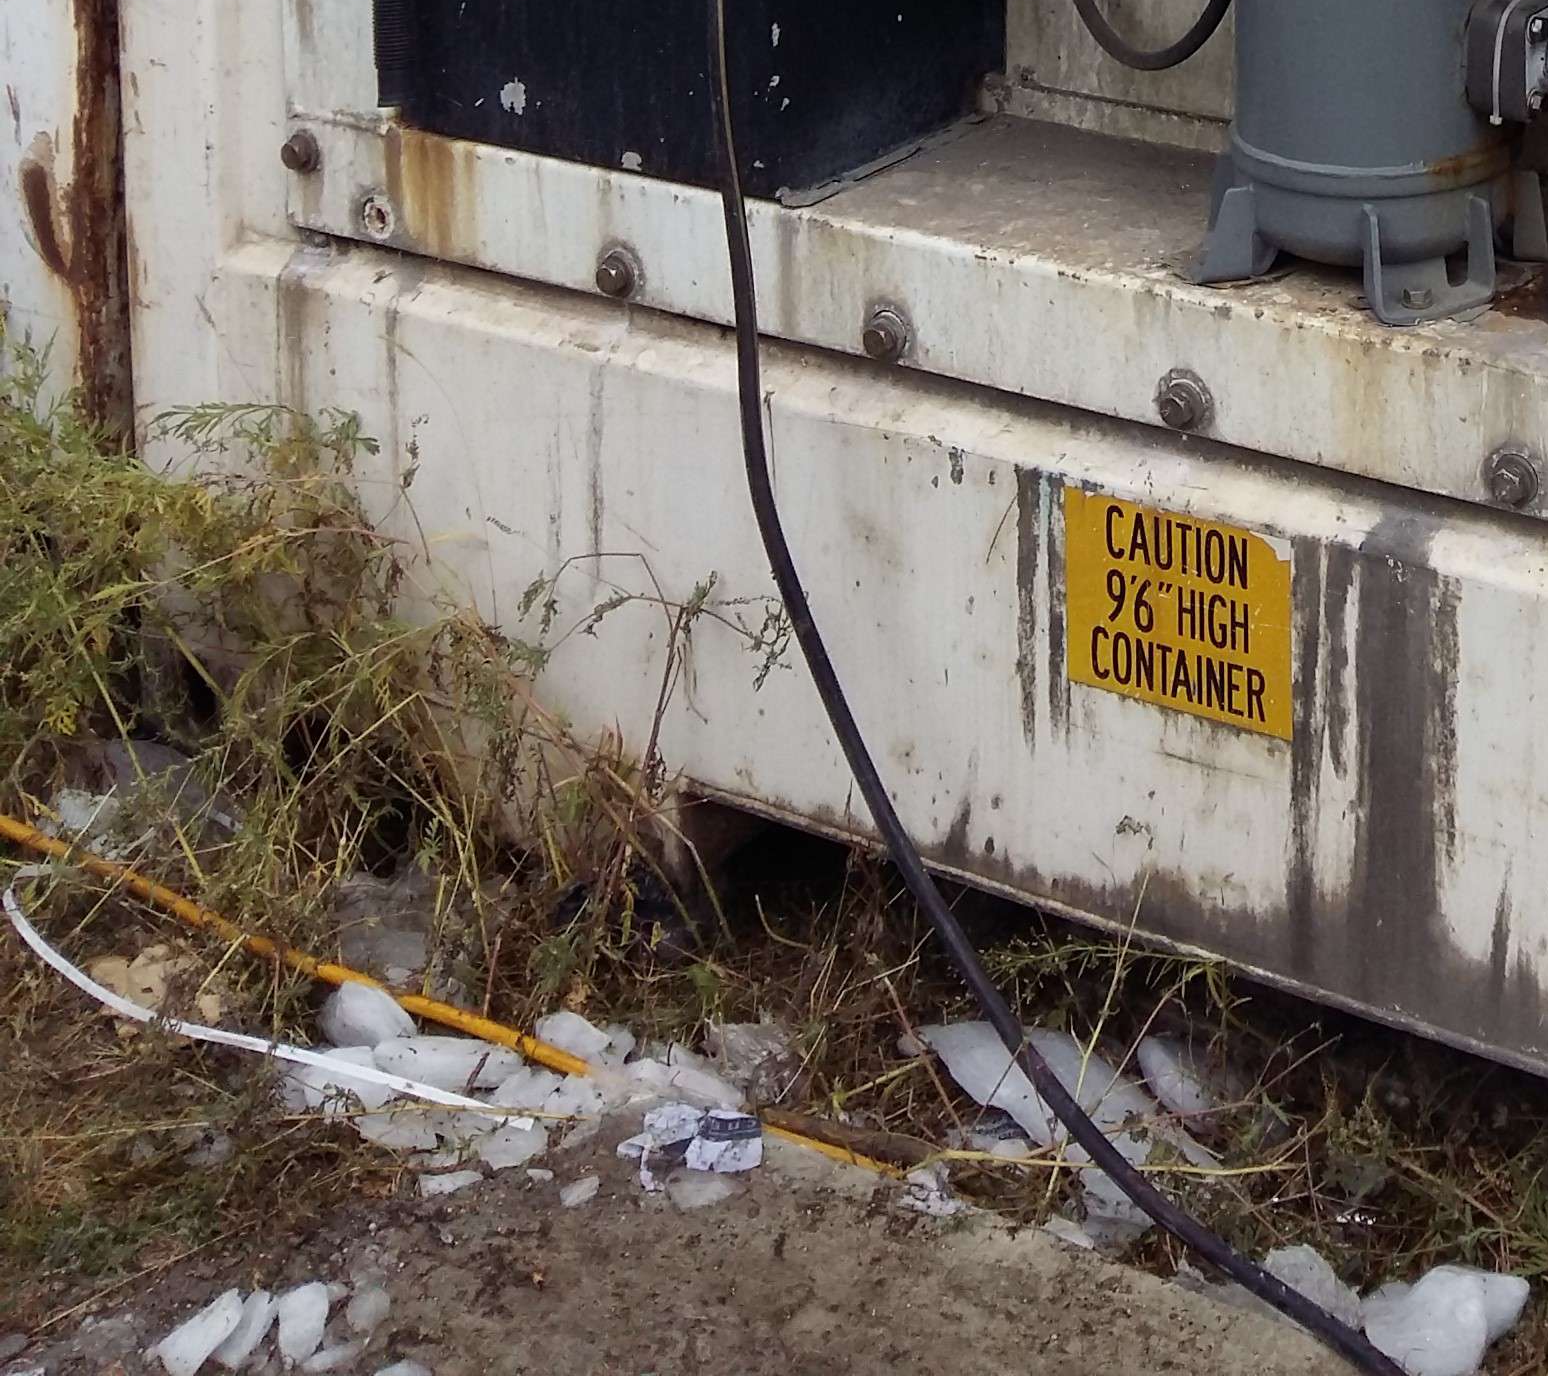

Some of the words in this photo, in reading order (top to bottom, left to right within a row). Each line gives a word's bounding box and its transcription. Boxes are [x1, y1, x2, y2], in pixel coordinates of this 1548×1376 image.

[1105, 504, 1248, 590] CAUTION
[1177, 585, 1249, 654] HIGH
[1090, 625, 1267, 723] CONTAINER
